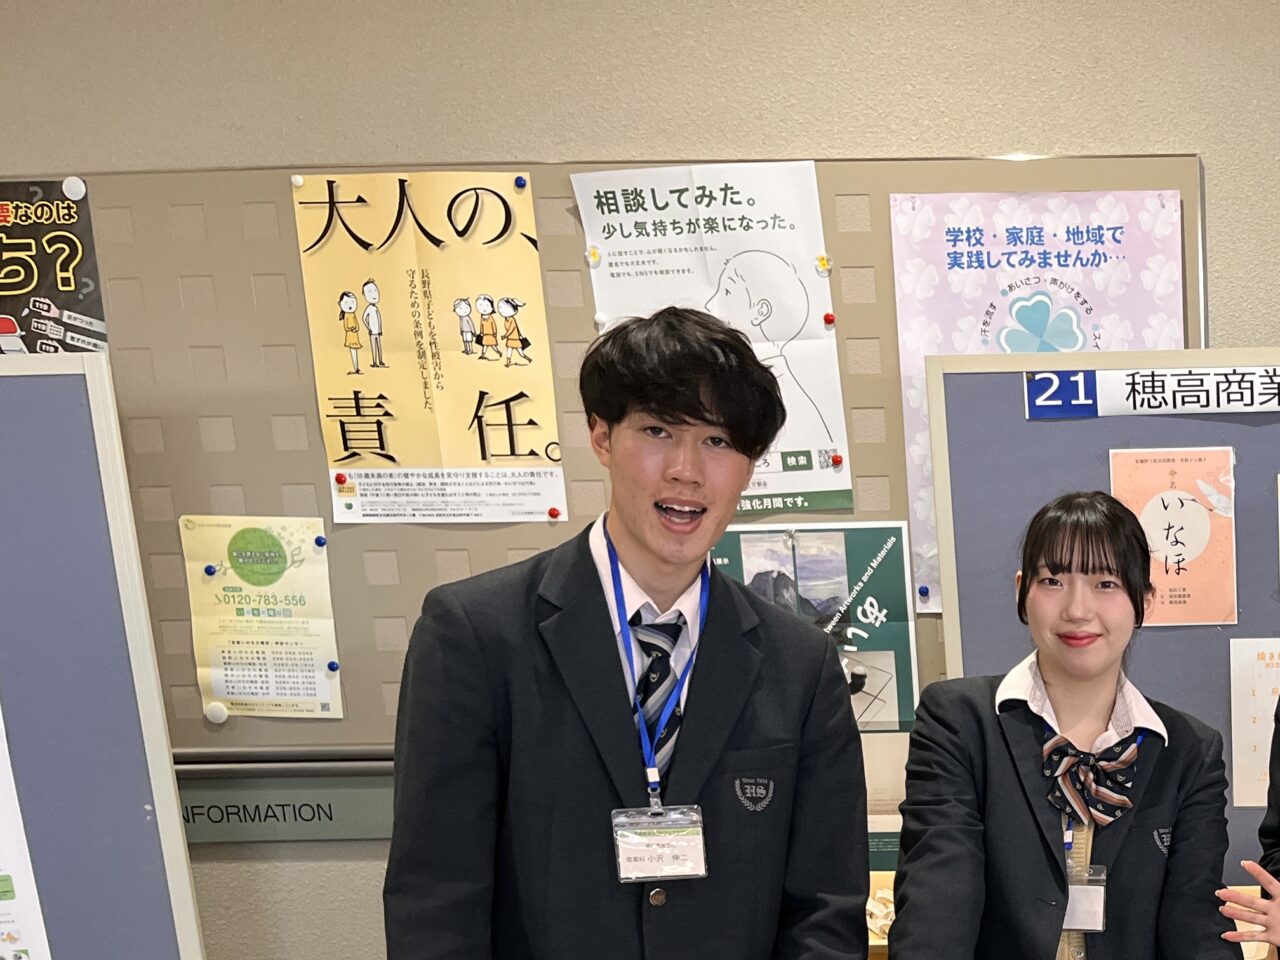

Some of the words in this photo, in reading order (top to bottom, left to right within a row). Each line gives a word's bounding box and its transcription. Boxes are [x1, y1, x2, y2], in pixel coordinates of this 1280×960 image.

[594, 183, 756, 215] 相談してみた。
[300, 178, 539, 254] 大人の、
[601, 213, 797, 240] 少し気持ちが楽になった。
[945, 225, 1125, 247] 学校・家庭・地域で
[1034, 372, 1094, 406] 21
[786, 454, 808, 467] 検索
[1161, 496, 1189, 577] いなほ
[824, 608, 842, 633] tween
[862, 566, 875, 583] and
[870, 535, 897, 569] Materials
[223, 594, 306, 606] 0120-783-556
[182, 802, 334, 826] NFORMATION
